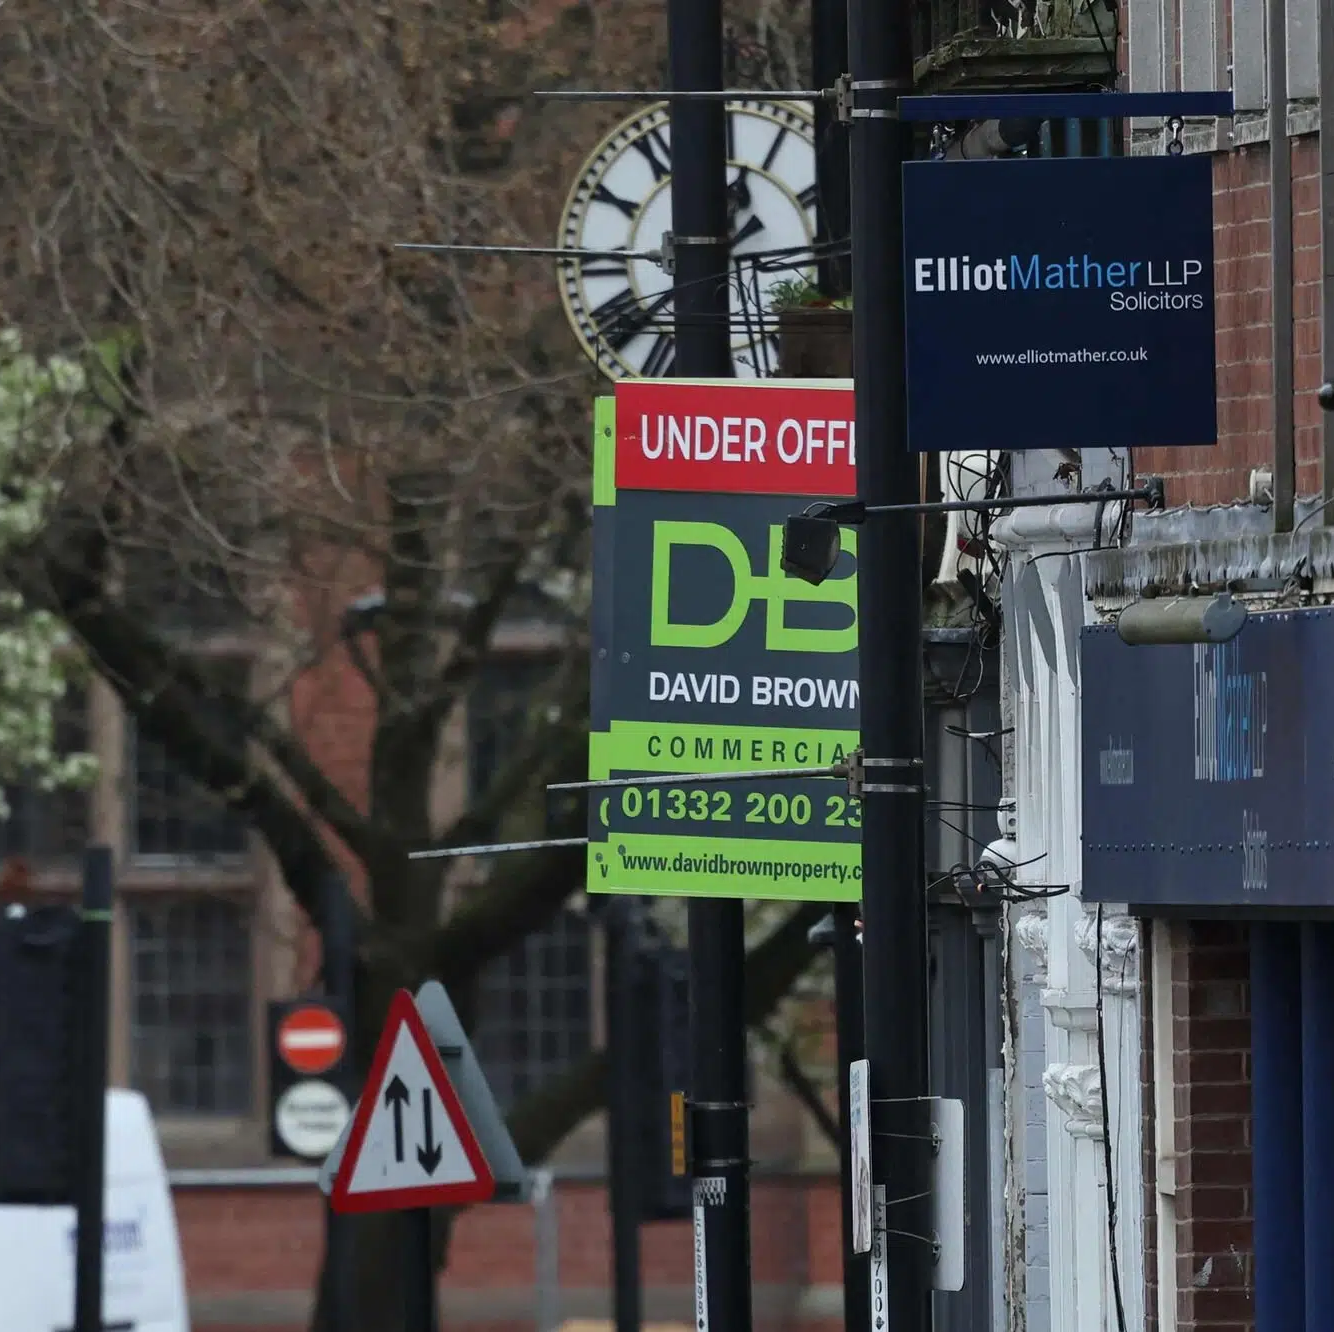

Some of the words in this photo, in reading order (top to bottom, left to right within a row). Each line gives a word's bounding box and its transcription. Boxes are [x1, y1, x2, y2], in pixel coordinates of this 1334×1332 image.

[915, 254, 1141, 292] ElliotMather
[1147, 260, 1202, 287] LLP
[1110, 292, 1203, 311] Solicitors
[976, 347, 1148, 365] www.elliotmather.co.uk
[641, 414, 766, 462] UNDER
[649, 671, 740, 704] DAVID
[648, 735, 847, 765] COMMERCIA
[621, 787, 731, 821] 01332
[745, 792, 812, 825] 200
[825, 796, 862, 828] 23
[622, 852, 862, 883] www.davidbrownproperty.c
